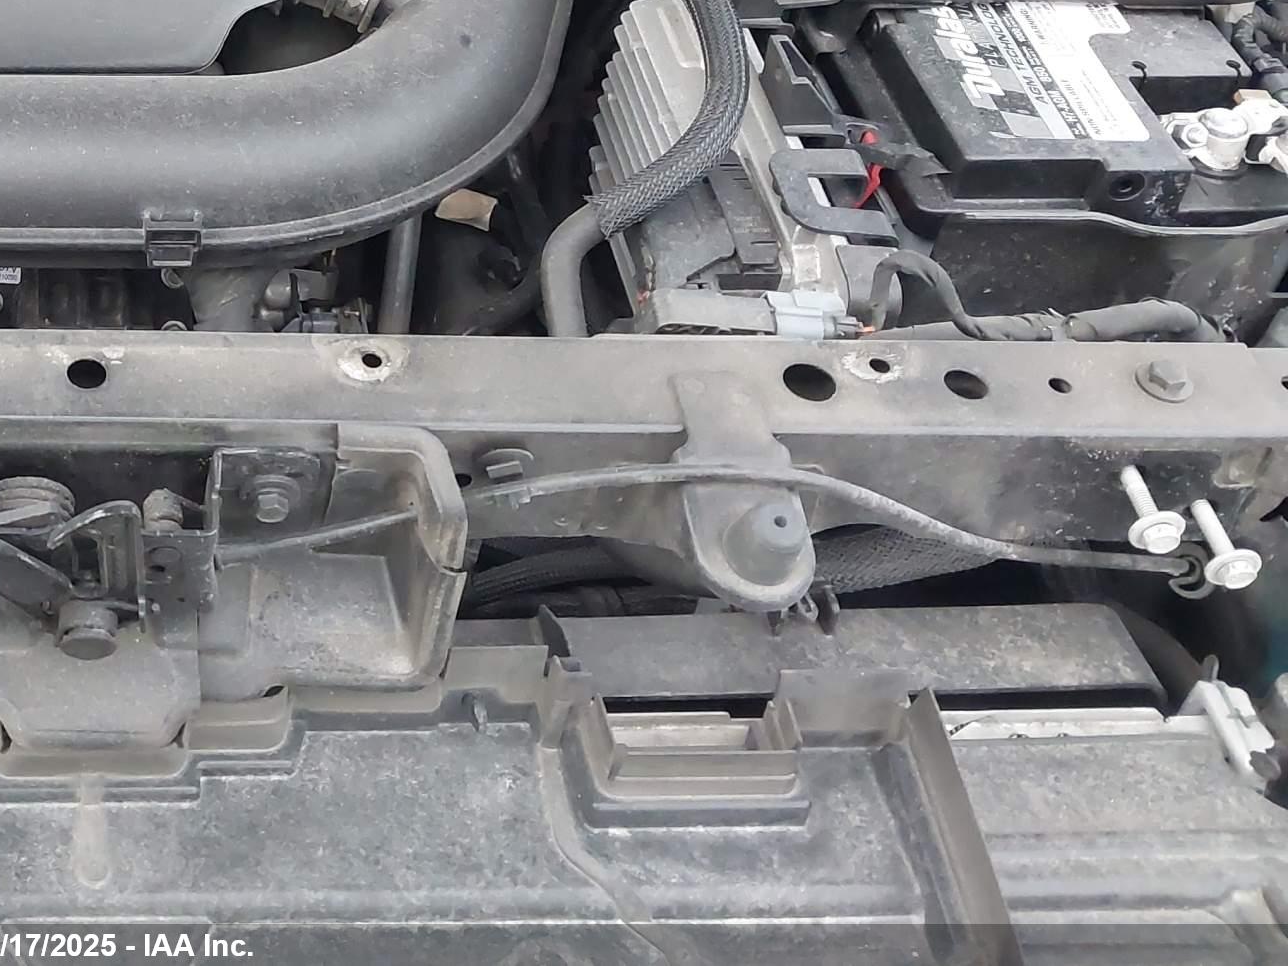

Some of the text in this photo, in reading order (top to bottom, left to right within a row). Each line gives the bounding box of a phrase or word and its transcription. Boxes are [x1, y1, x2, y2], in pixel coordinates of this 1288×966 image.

[931, 2, 1005, 99] Duralas
[977, 2, 1026, 71] TECHNOLOG
[1022, 75, 1049, 105] AGM
